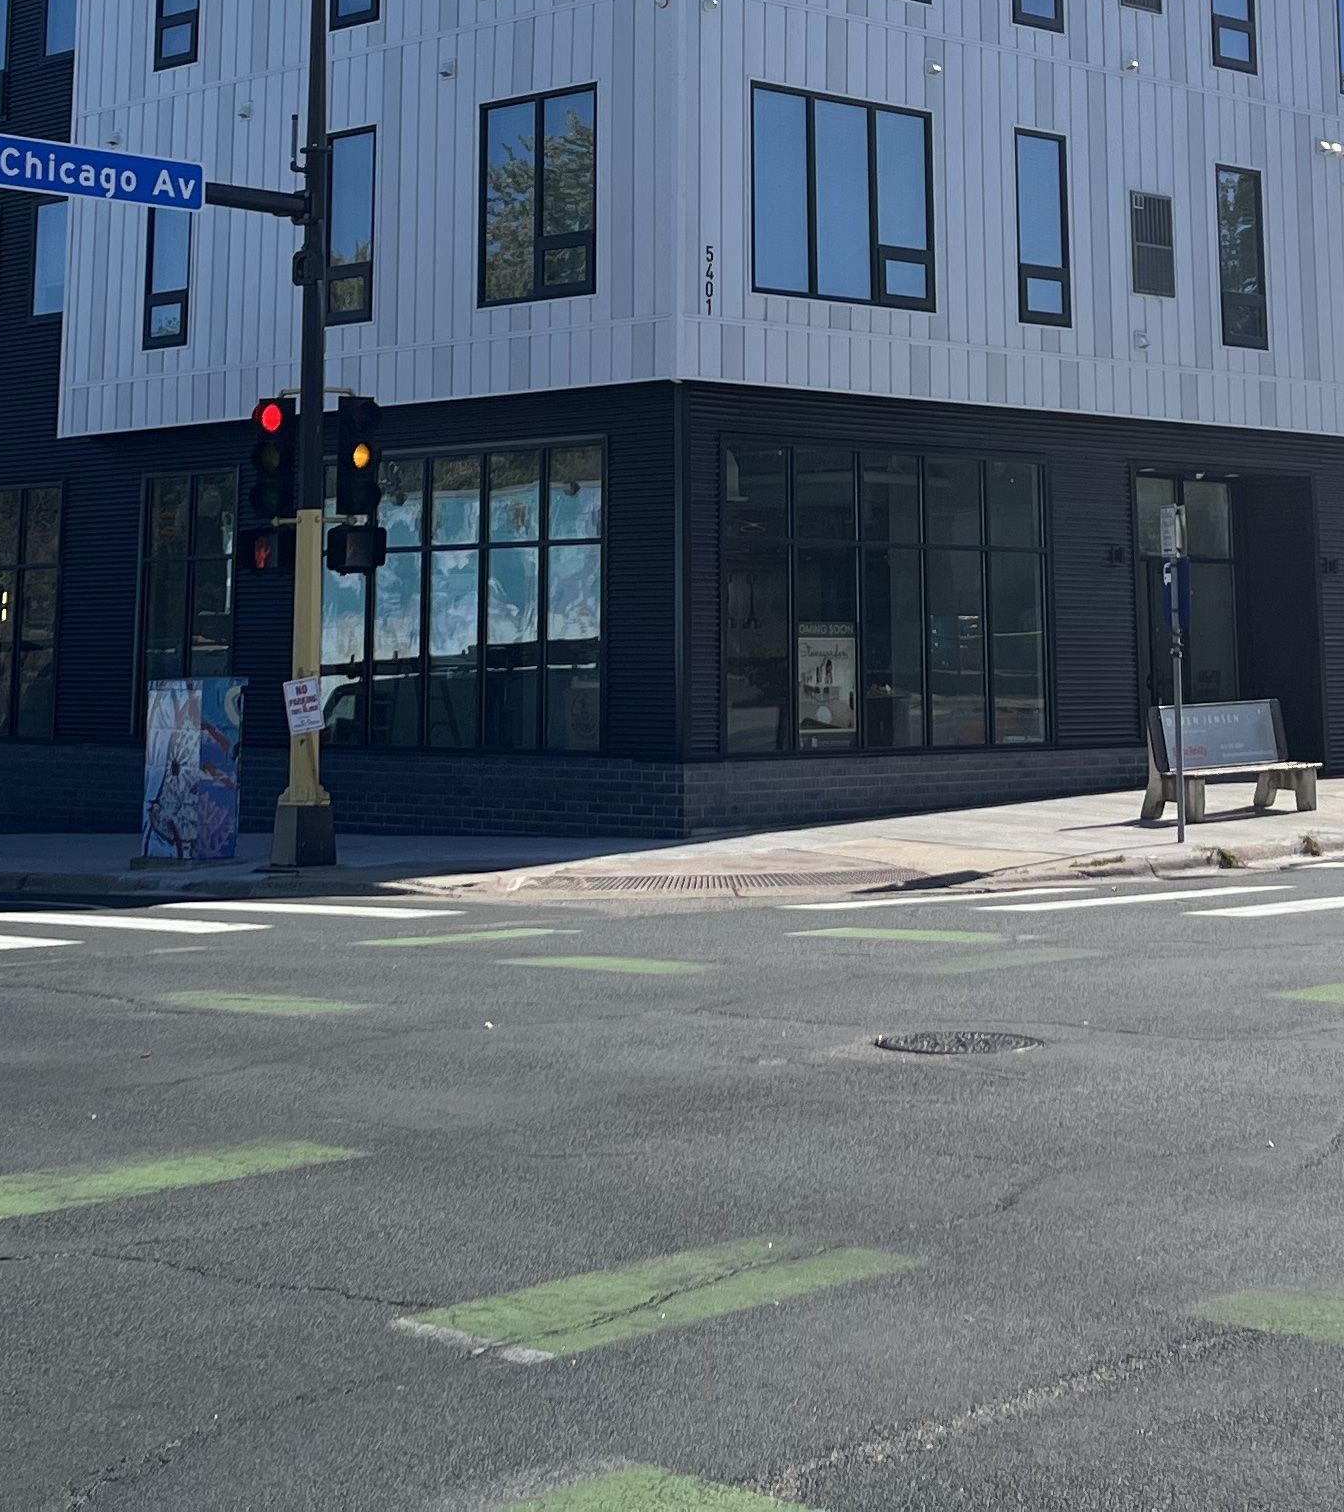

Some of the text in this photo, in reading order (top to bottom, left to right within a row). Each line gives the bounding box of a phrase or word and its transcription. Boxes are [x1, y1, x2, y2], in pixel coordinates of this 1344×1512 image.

[0, 147, 196, 200] Chicago Av
[705, 245, 714, 316] 5401
[296, 684, 307, 696] NO
